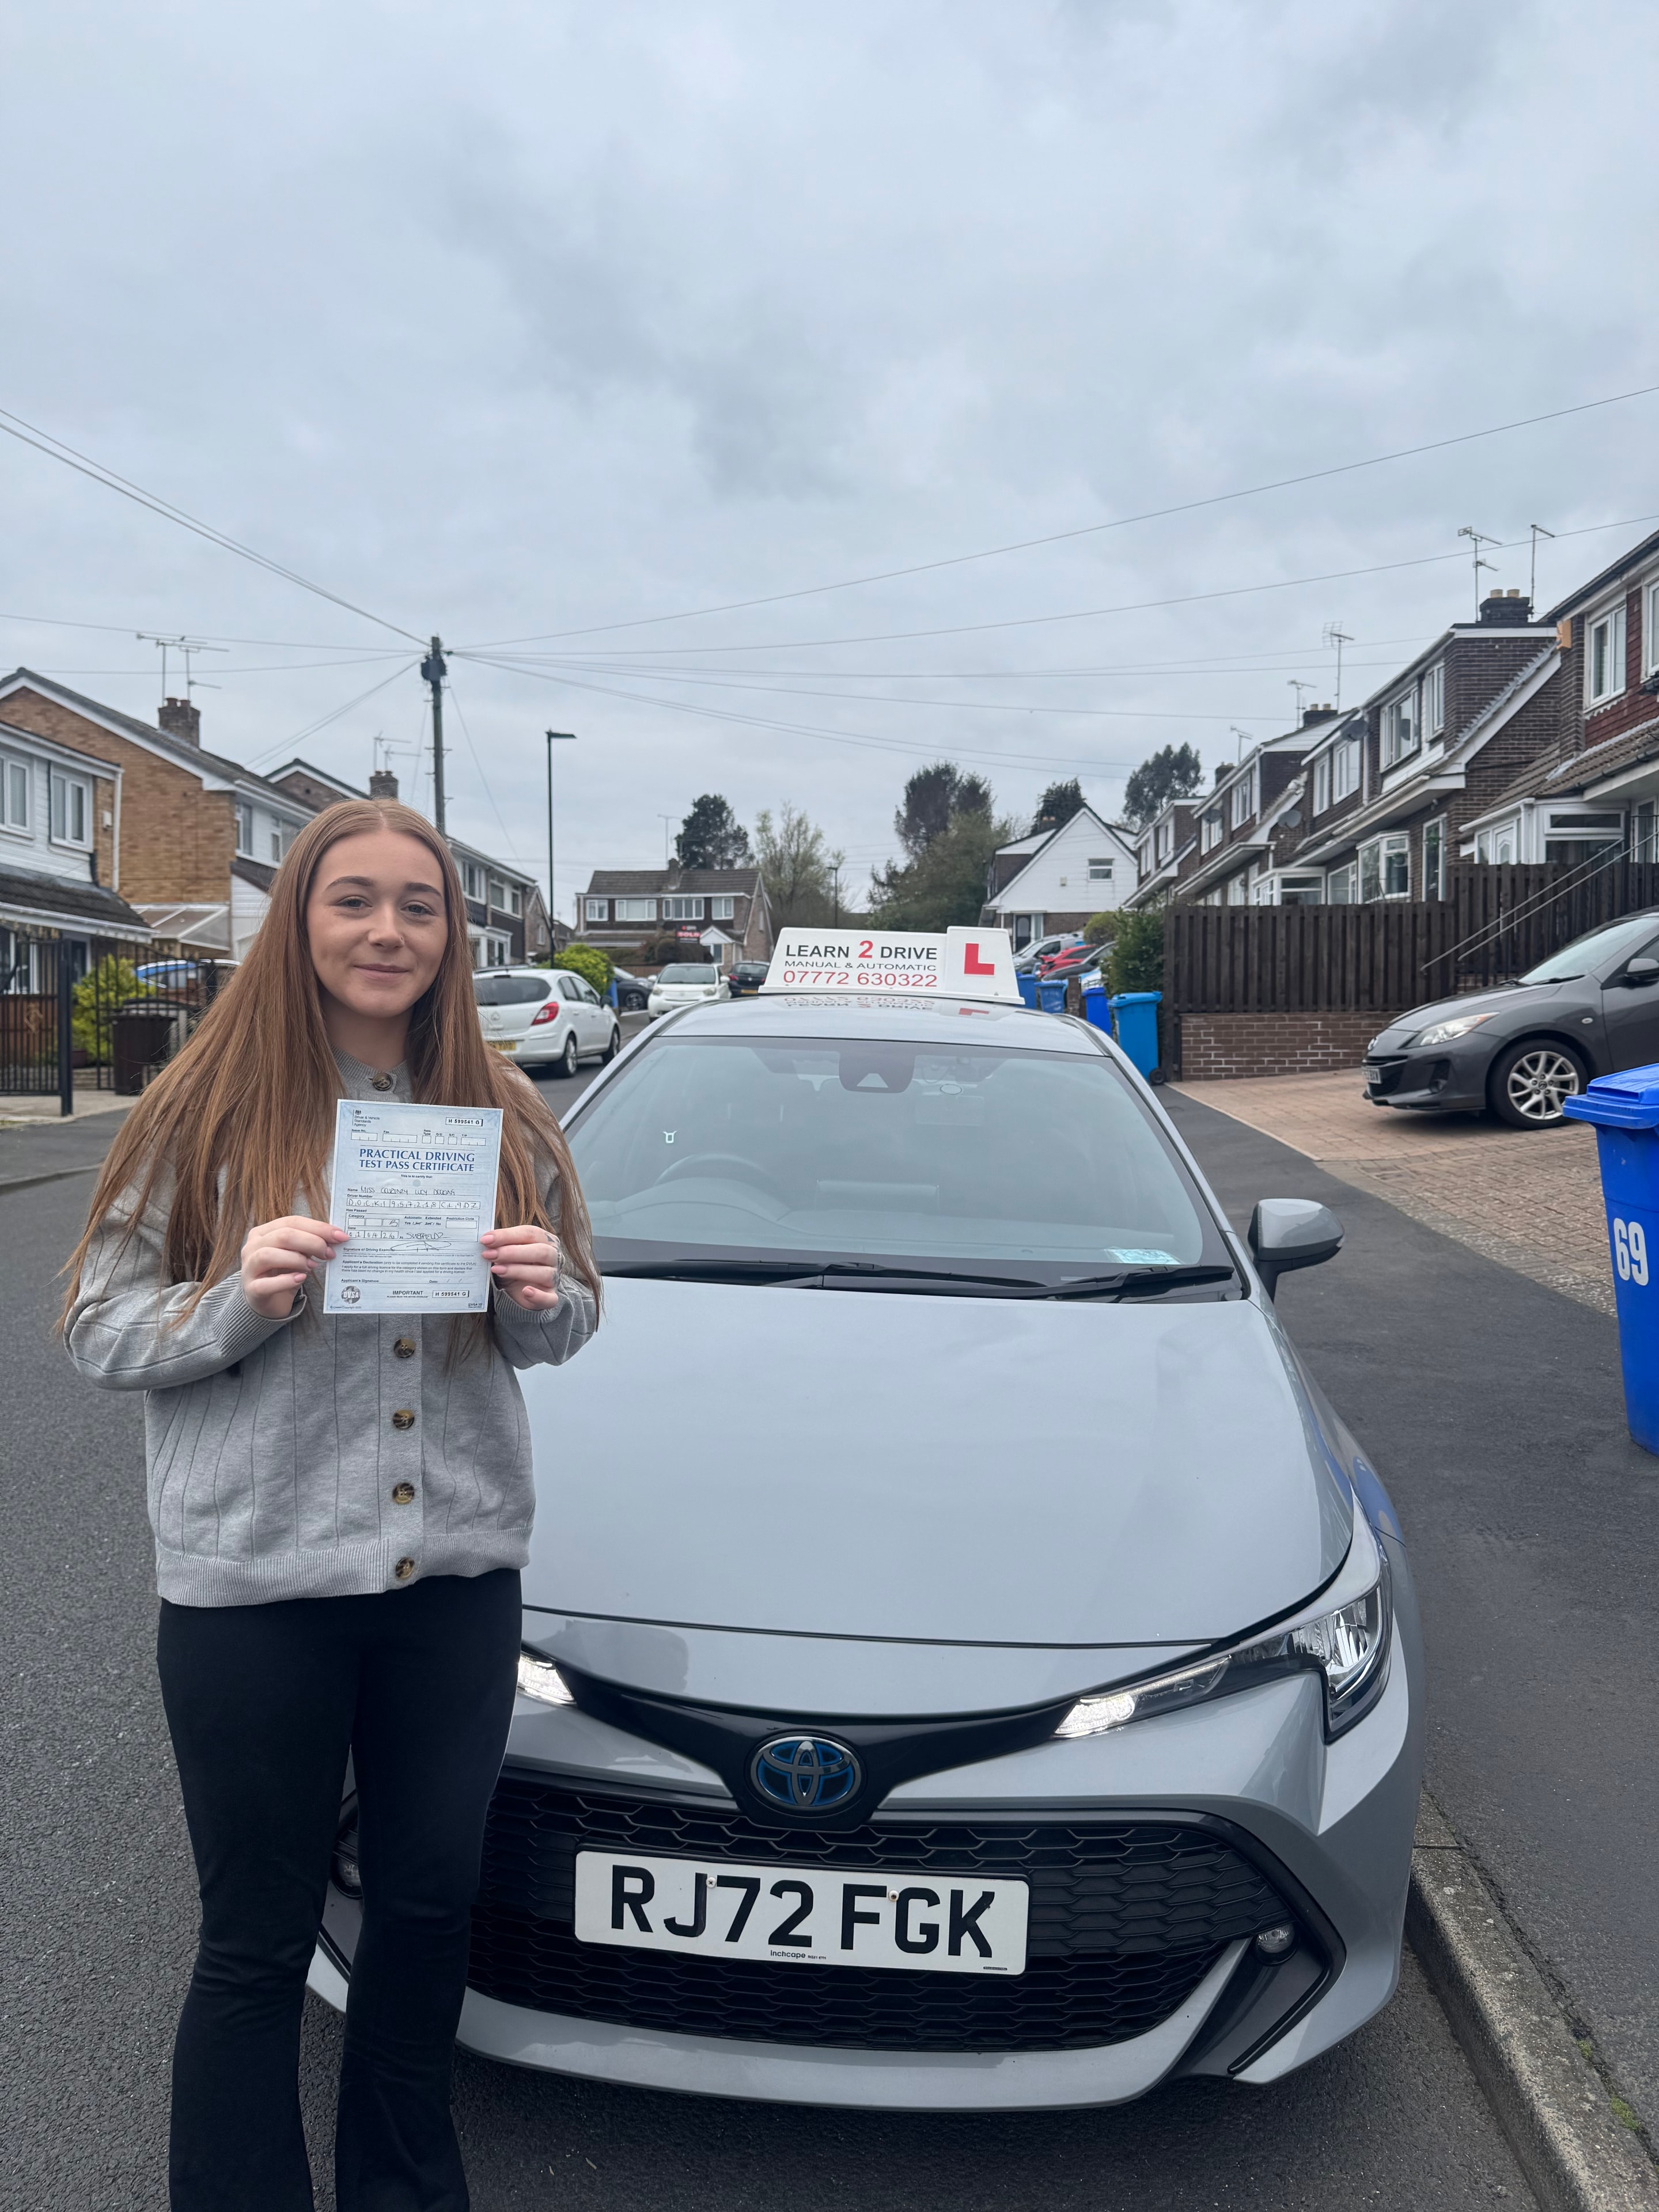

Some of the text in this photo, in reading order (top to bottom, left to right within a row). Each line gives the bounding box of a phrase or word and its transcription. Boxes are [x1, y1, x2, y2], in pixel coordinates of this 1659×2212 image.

[786, 940, 938, 960] LEARN 2 DRIVE
[857, 963, 937, 971] AUTOMATIC
[964, 942, 995, 976] L
[783, 970, 938, 987] 07772 630322
[359, 1149, 475, 1162] PRACTICAL DRIVING
[359, 1160, 475, 1172] TEST PASS CERTIFICATE
[1613, 1218, 1649, 1286] 69
[611, 1864, 995, 1959] RJ72 FGK
[770, 1949, 806, 1959] Inchcape
